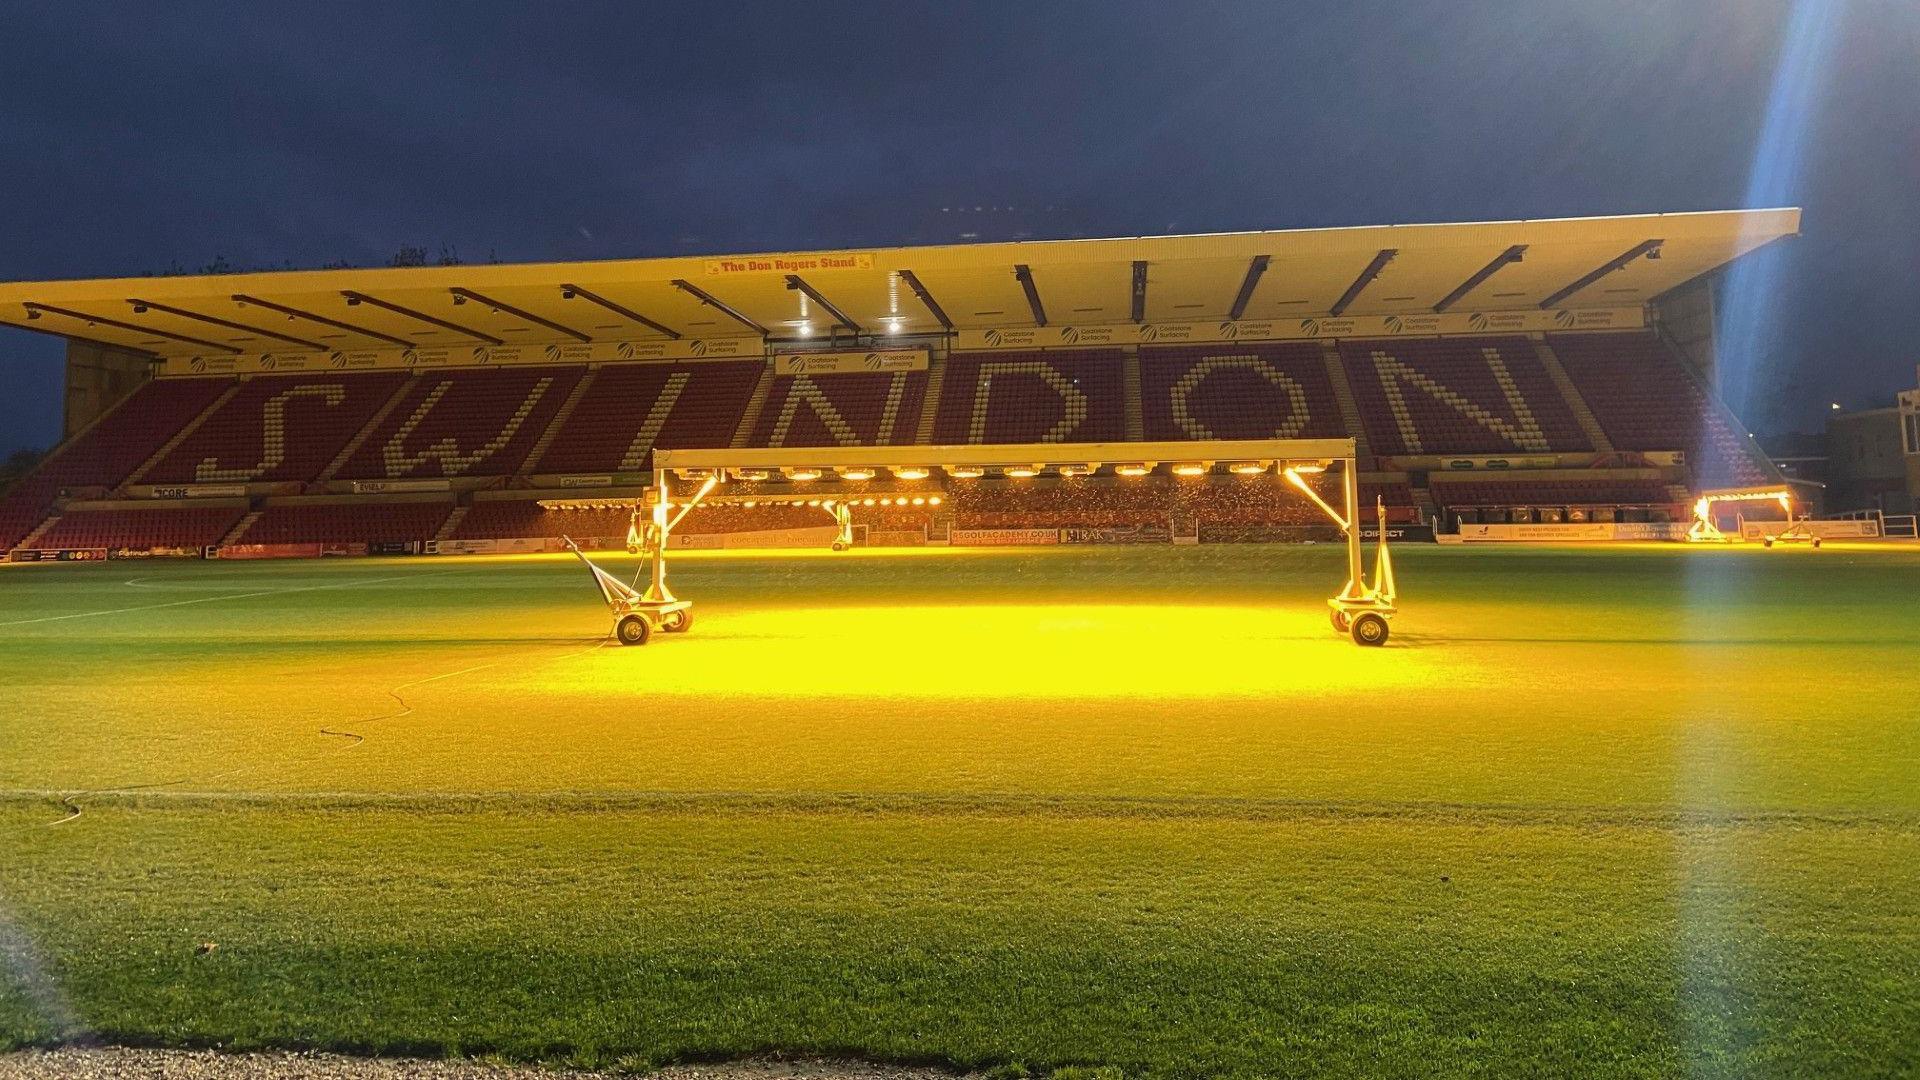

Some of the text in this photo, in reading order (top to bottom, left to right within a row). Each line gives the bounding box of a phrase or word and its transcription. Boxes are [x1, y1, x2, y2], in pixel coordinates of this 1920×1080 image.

[721, 257, 855, 272] The Don Rogers Stand
[195, 346, 1550, 482] SWINDON
